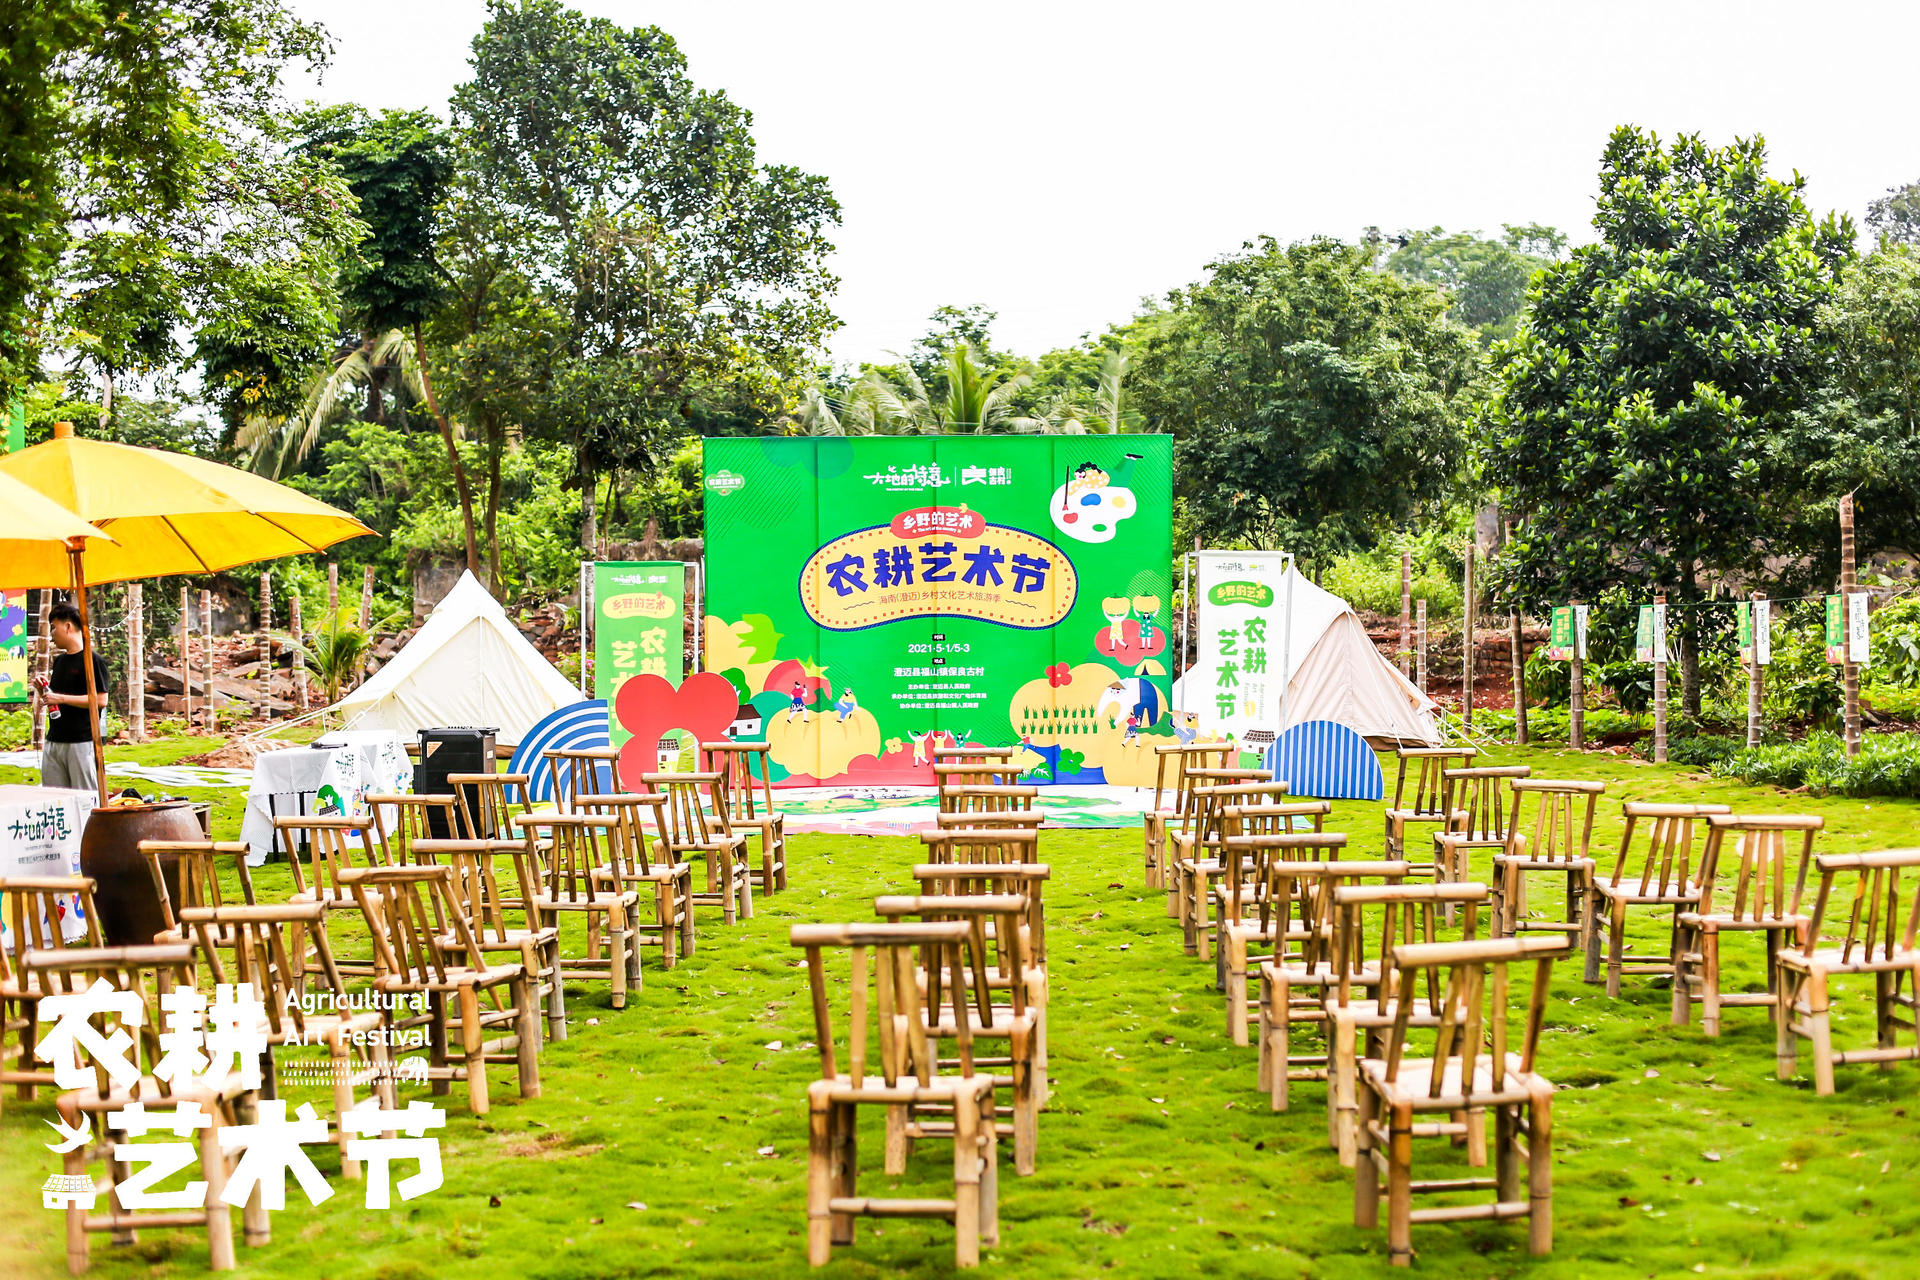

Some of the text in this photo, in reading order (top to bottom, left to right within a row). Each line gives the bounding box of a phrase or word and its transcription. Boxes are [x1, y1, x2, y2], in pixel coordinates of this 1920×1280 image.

[903, 511, 973, 530] 乡野的艺术
[826, 541, 1051, 597] 农耕艺术节
[879, 589, 1002, 606] 海南(澄迈)乡村文化艺术旅游季
[1217, 584, 1267, 600] 乡野的艺术
[613, 597, 666, 610] 乡野的艺术
[1241, 616, 1267, 674] 农耕
[894, 667, 985, 677] 澄迈县福山镇保良古村
[1215, 628, 1240, 719] 艺术节
[7, 803, 72, 841] 大地的诗意
